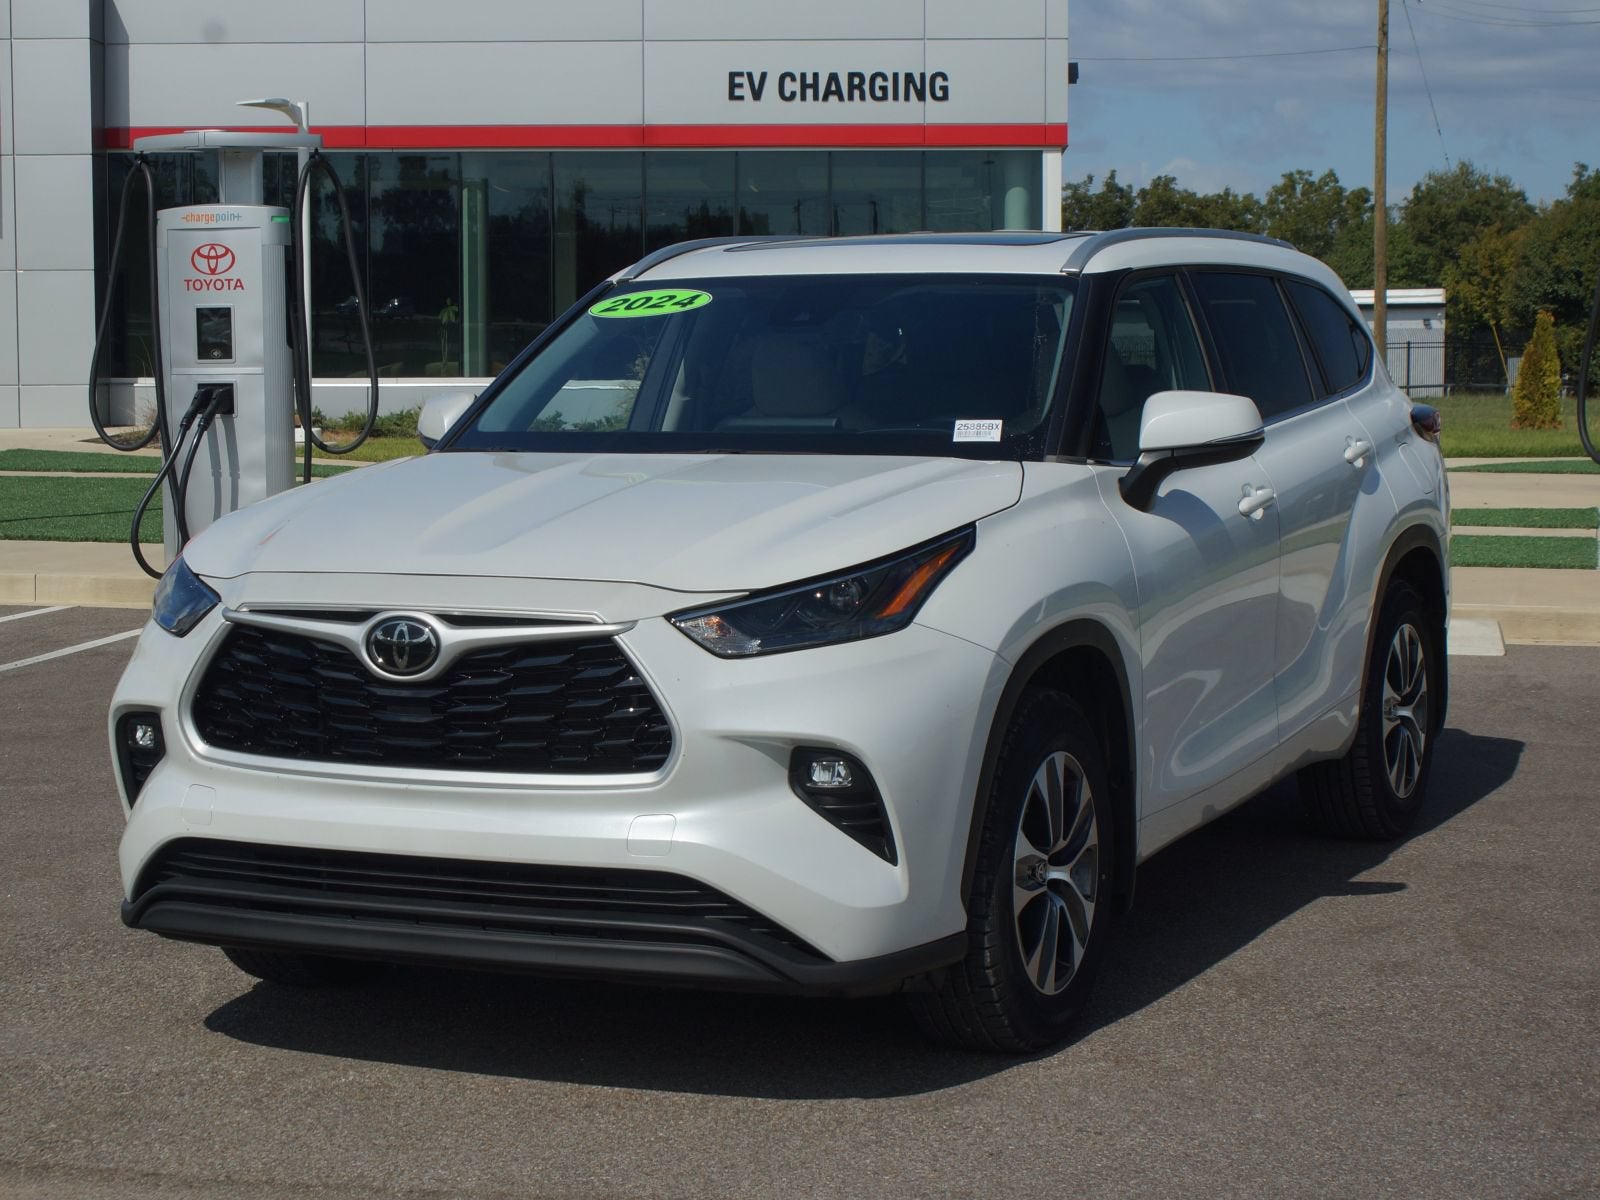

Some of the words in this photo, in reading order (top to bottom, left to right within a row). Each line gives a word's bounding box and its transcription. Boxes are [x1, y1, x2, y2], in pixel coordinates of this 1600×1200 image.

[728, 71, 768, 101] EV
[778, 71, 950, 102] CHARGING
[184, 278, 245, 292] TOYOTA
[597, 293, 703, 314] 2024
